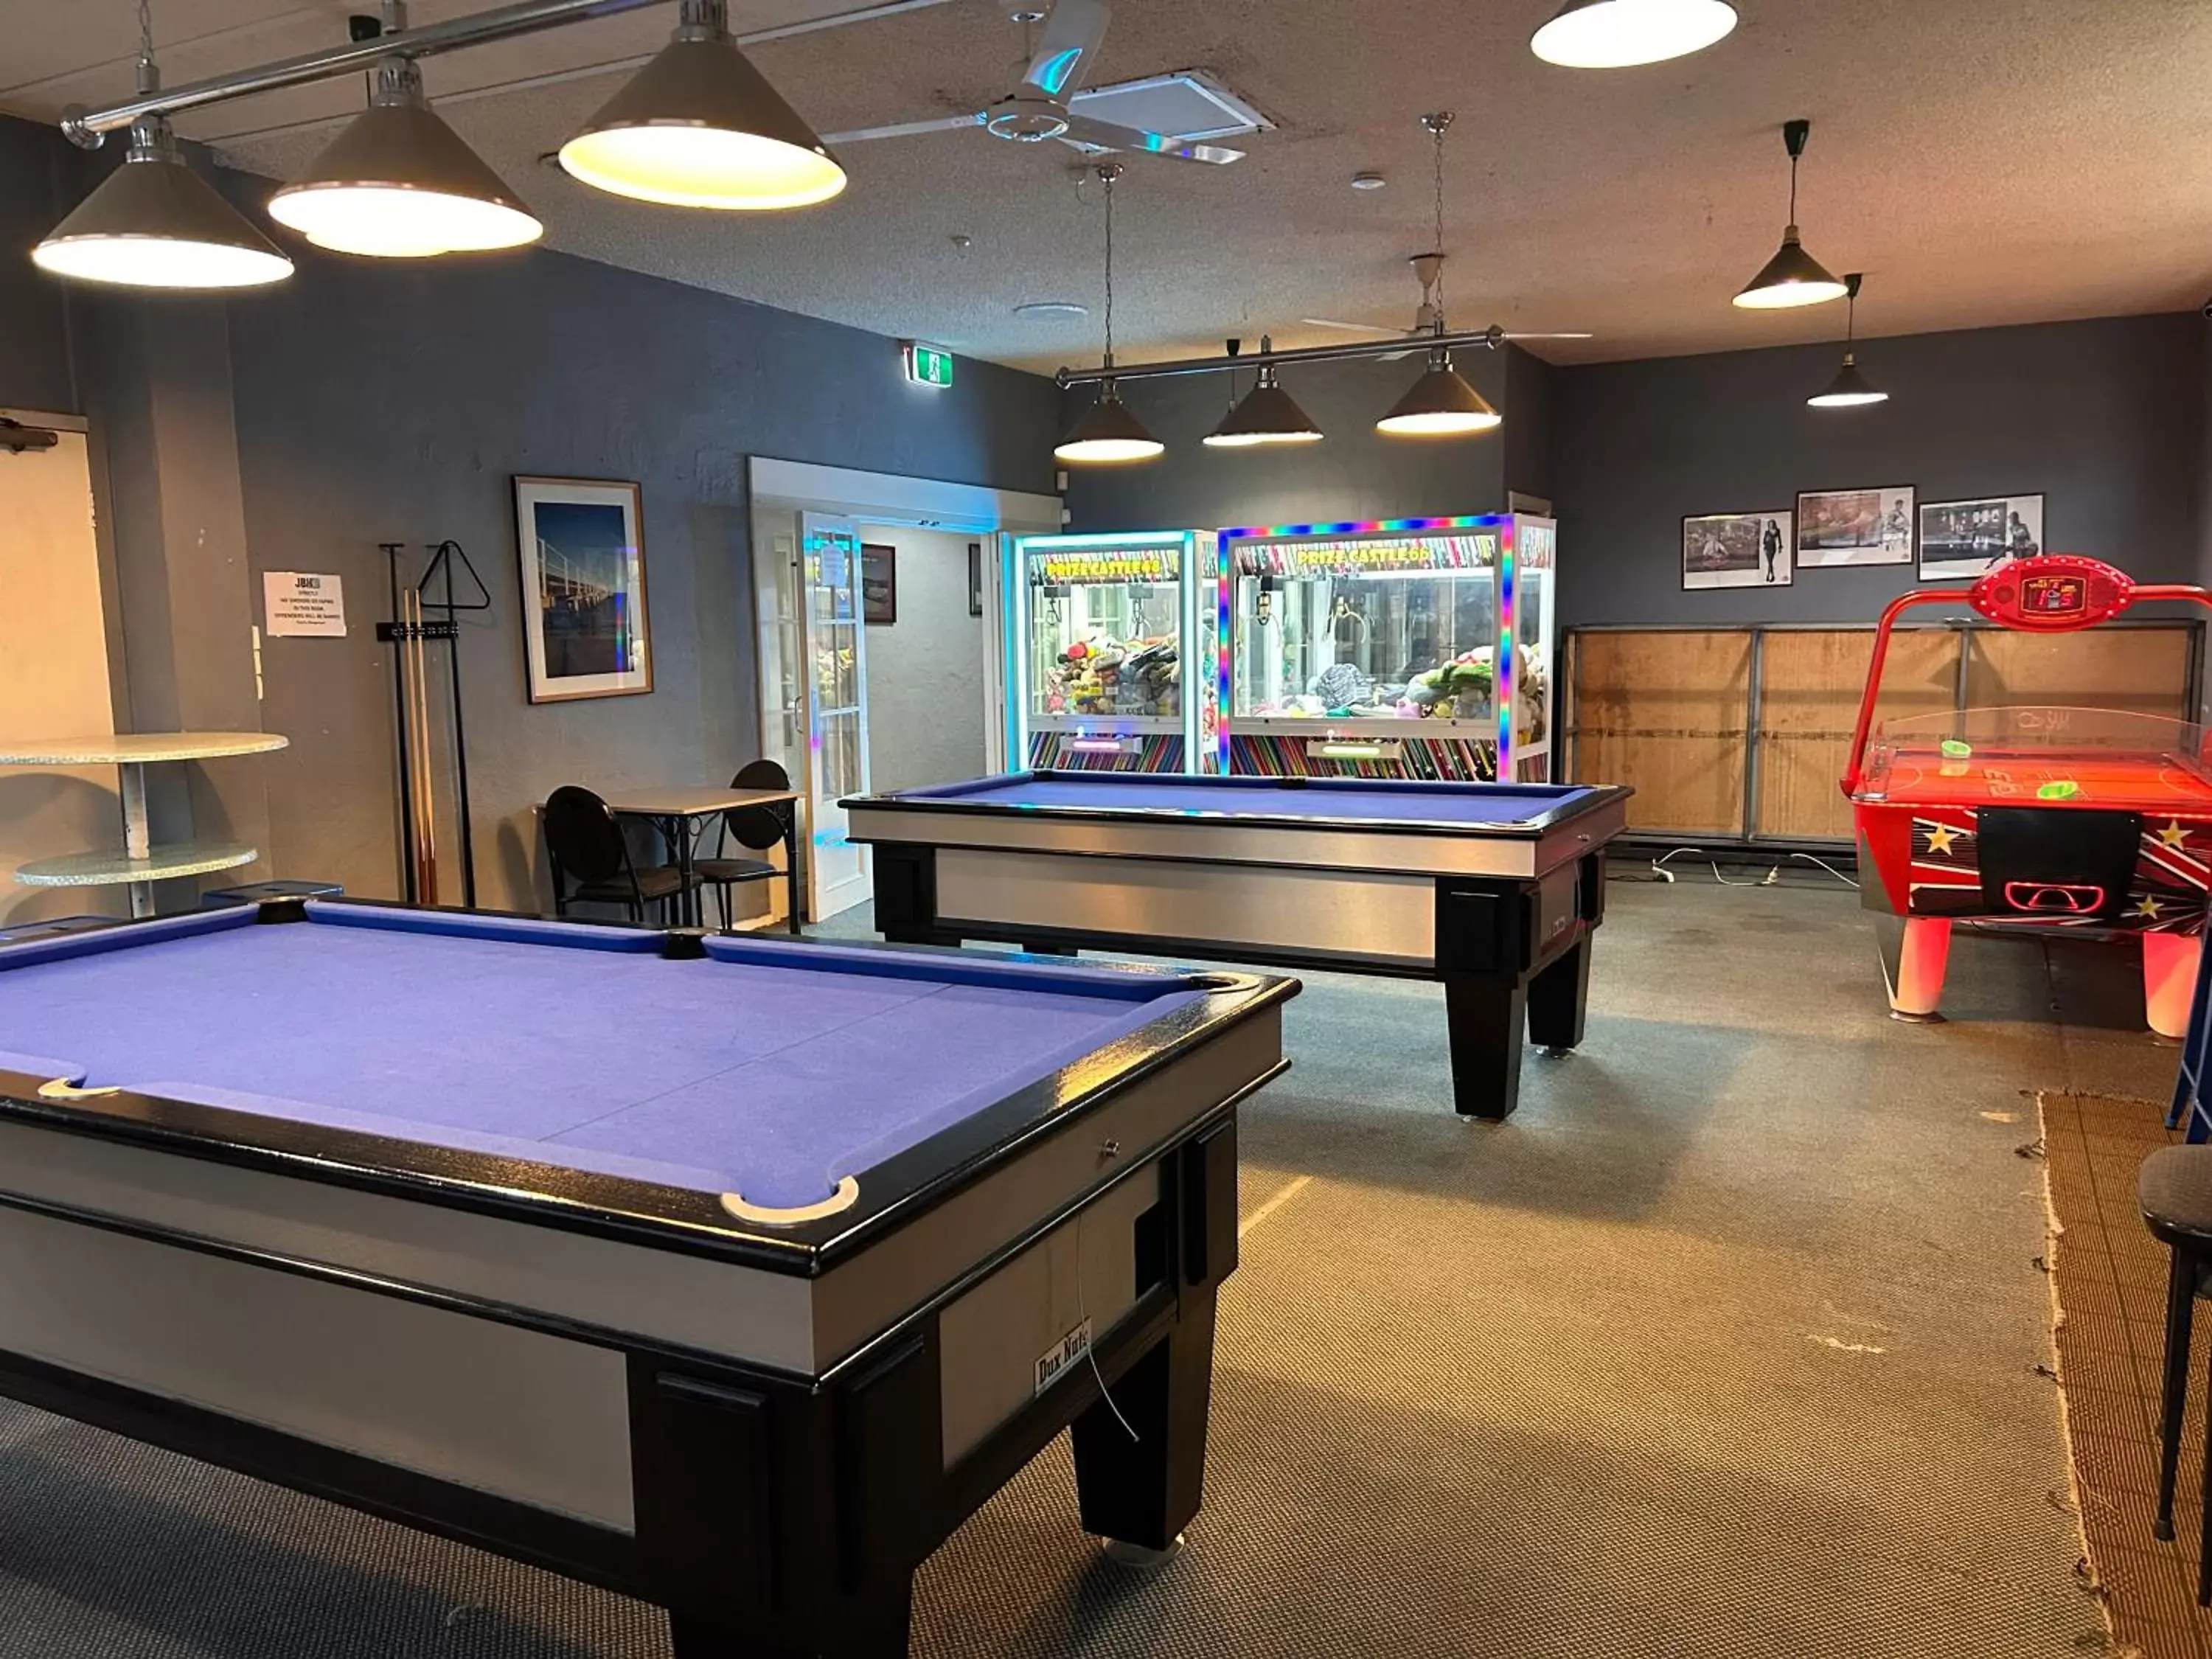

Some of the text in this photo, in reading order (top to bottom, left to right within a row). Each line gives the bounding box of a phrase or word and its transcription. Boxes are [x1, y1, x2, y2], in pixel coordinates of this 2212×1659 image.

[1297, 549, 1346, 565] PRIZE
[1047, 560, 1088, 577] PRIZE
[1039, 1352, 1062, 1385] Dux
